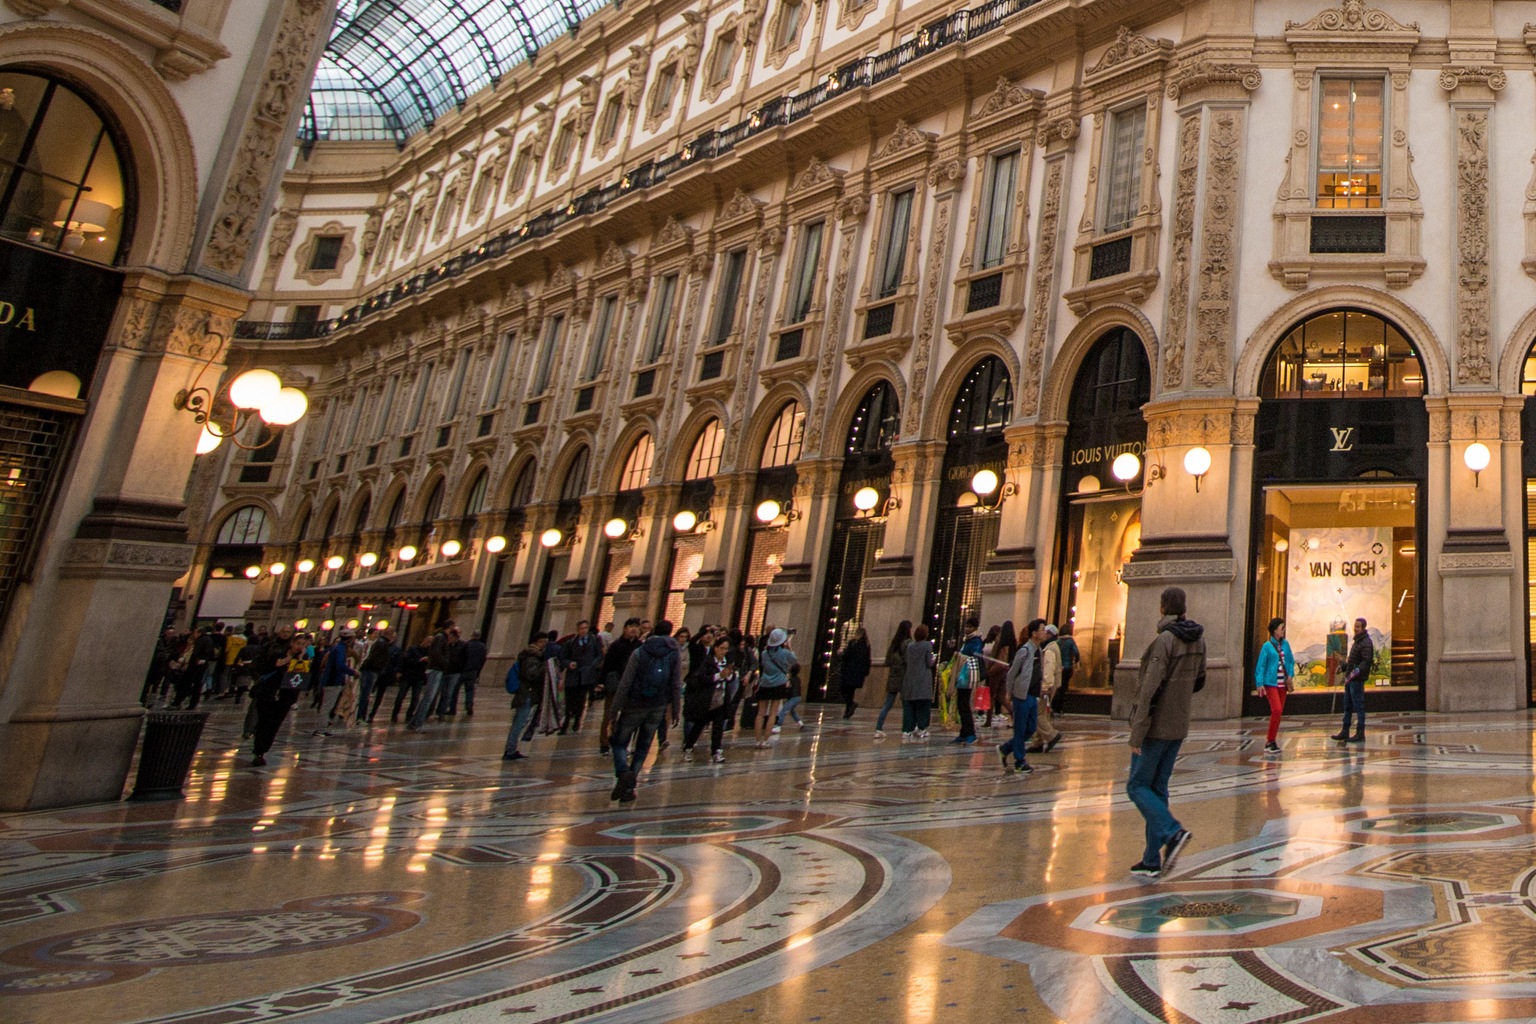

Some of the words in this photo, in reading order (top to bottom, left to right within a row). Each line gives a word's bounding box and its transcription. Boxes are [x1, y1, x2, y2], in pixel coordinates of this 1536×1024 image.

[1071, 446, 1102, 465] LOUIS
[1309, 561, 1332, 577] VAN
[1341, 560, 1376, 576] GOGH
